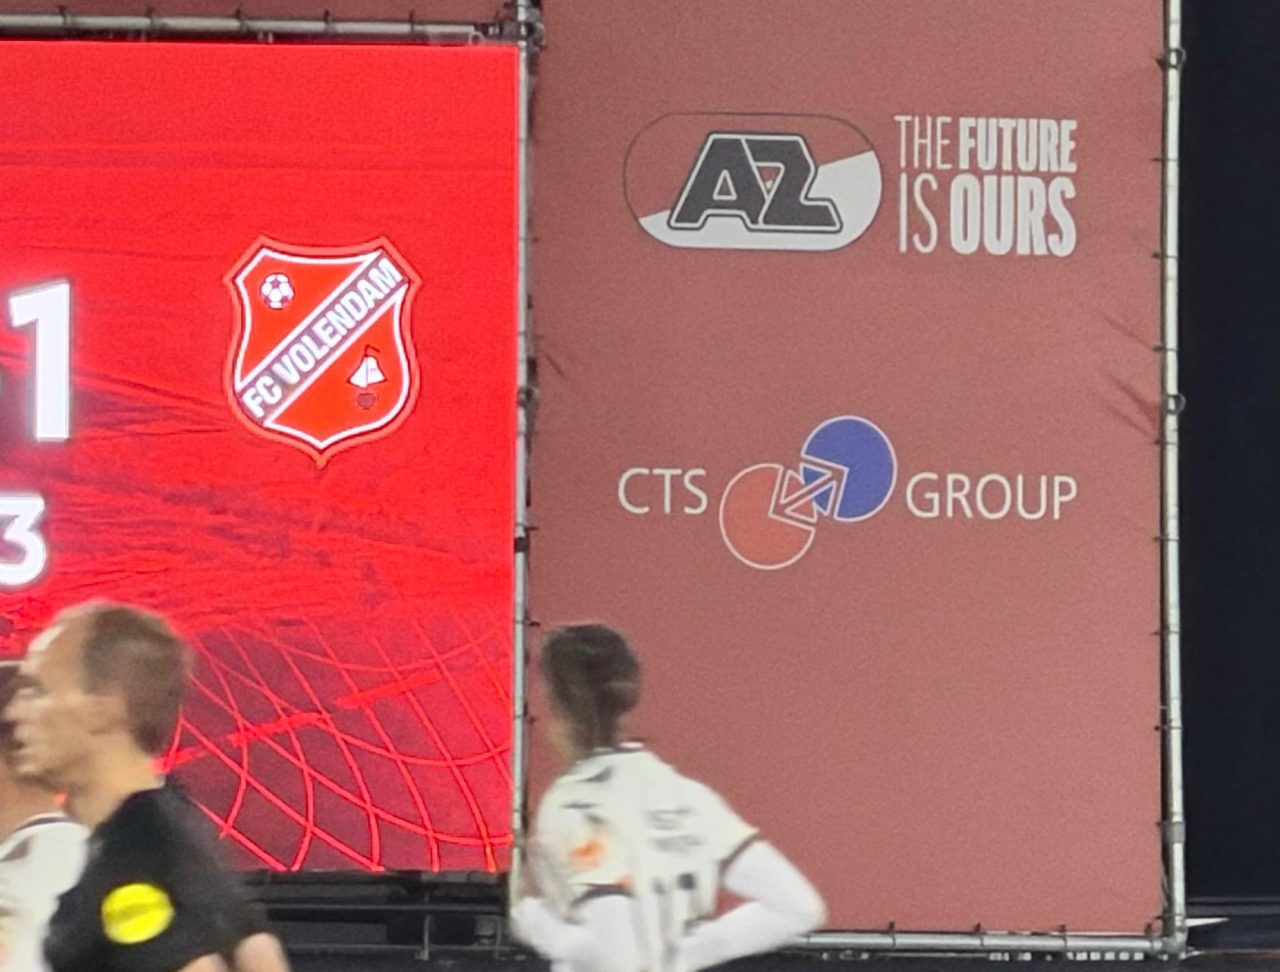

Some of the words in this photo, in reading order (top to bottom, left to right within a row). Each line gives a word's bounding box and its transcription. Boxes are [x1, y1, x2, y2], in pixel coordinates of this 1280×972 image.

[894, 115, 953, 170] THE
[958, 117, 1078, 172] FUTURE
[898, 172, 939, 253] IS
[949, 173, 1077, 258] OURS
[241, 374, 283, 419] FC
[272, 256, 405, 386] VOLENDAM
[617, 468, 708, 514] CTS
[905, 472, 1078, 520] GROUP
